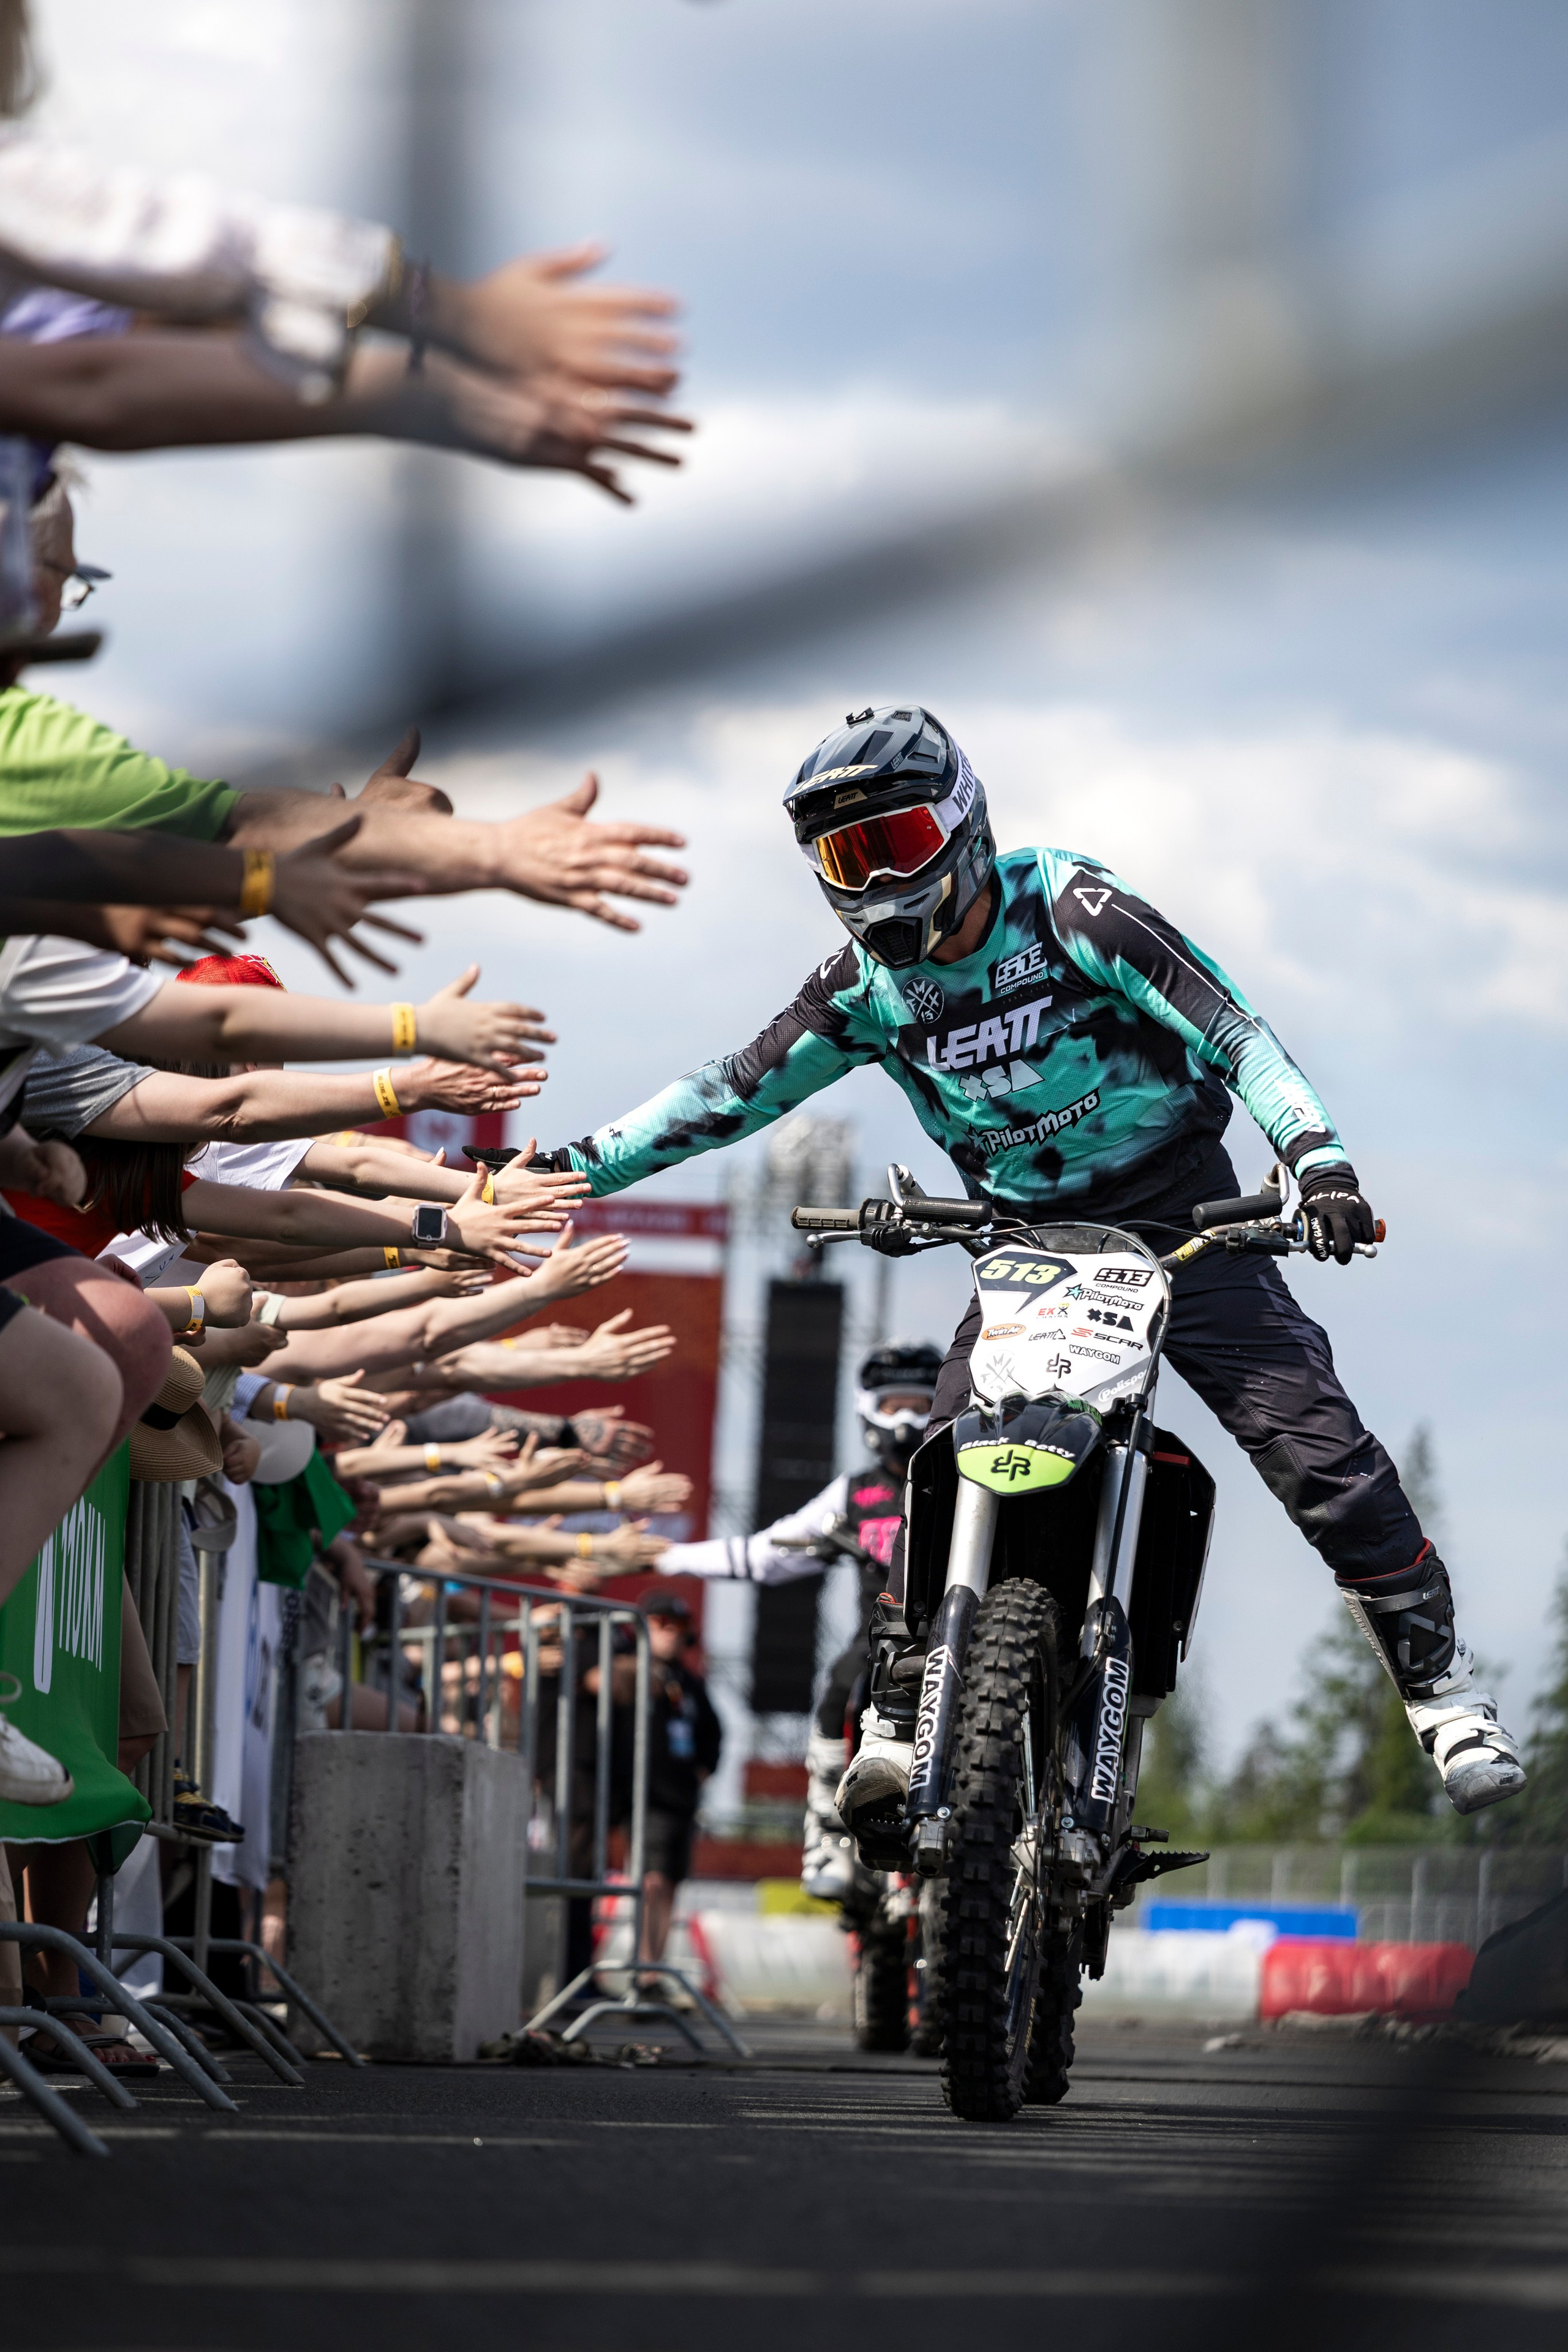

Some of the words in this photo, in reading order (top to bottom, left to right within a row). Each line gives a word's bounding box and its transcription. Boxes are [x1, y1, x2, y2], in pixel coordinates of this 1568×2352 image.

[891, 752, 904, 770] LEATT
[789, 765, 878, 797] LEATT
[838, 792, 858, 804] LEATT
[1000, 971, 1044, 994] COMPOUND
[927, 995, 1053, 1071] LEATT
[1304, 1191, 1360, 1205] ALIPA
[1315, 1238, 1327, 1258] ALIPA
[979, 1259, 1061, 1284] 513
[1095, 1283, 1139, 1294] COMPOUND
[1038, 1307, 1057, 1316] EK
[1093, 1332, 1144, 1351] SCAR
[1069, 1344, 1121, 1365] WAYGOM
[959, 1436, 1010, 1451] Black
[1024, 1439, 1076, 1458] Betty
[909, 1645, 949, 1792] WAYGOM
[1090, 1656, 1129, 1804] WAYGOM
